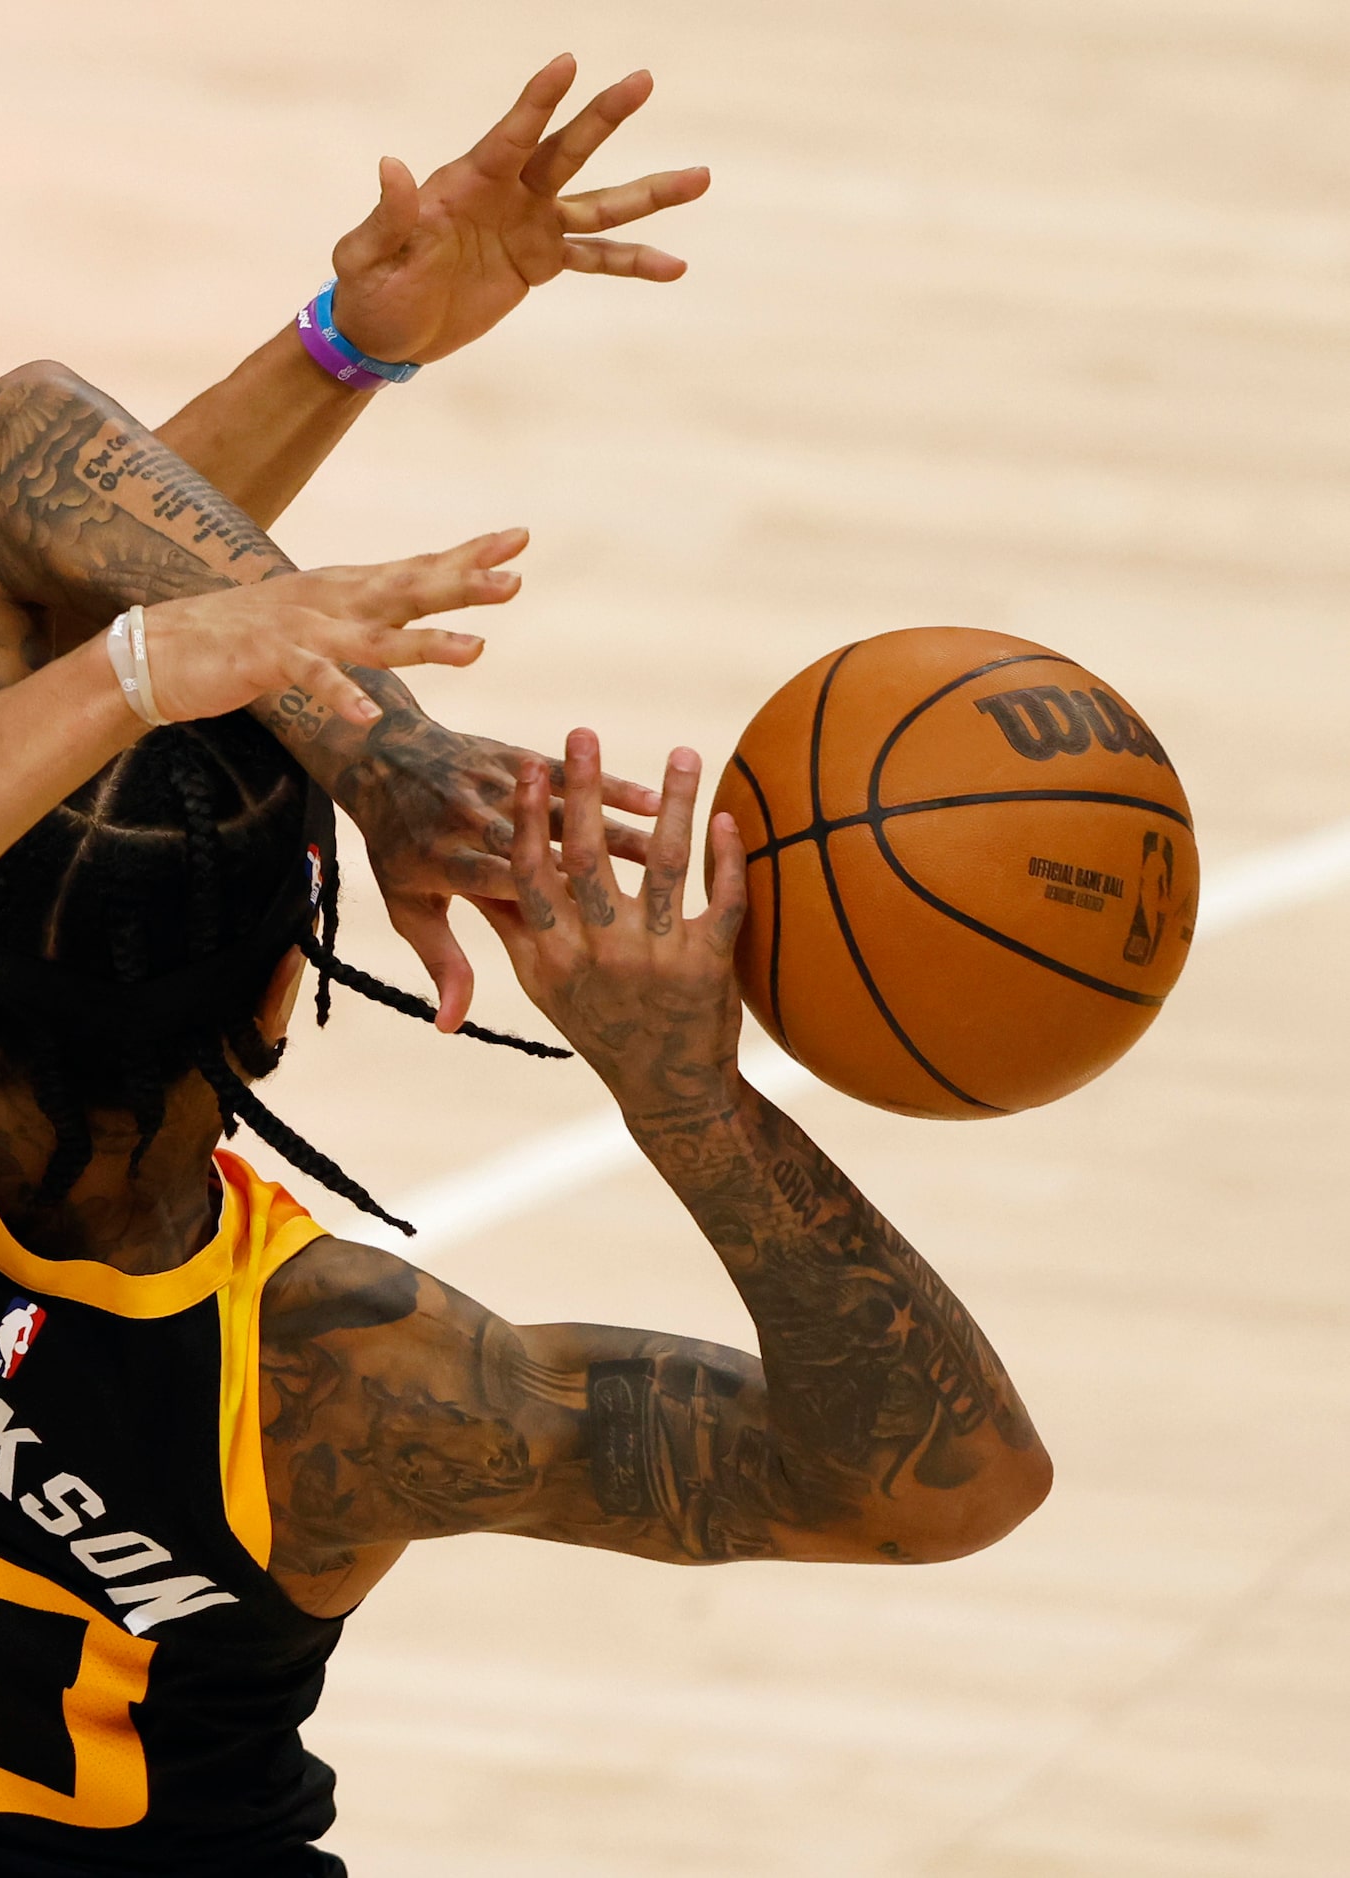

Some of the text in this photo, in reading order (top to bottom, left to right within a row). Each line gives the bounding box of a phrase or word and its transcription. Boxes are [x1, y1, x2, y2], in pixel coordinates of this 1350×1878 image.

[1028, 856, 1124, 899] OFFICIAL GAME BALL
